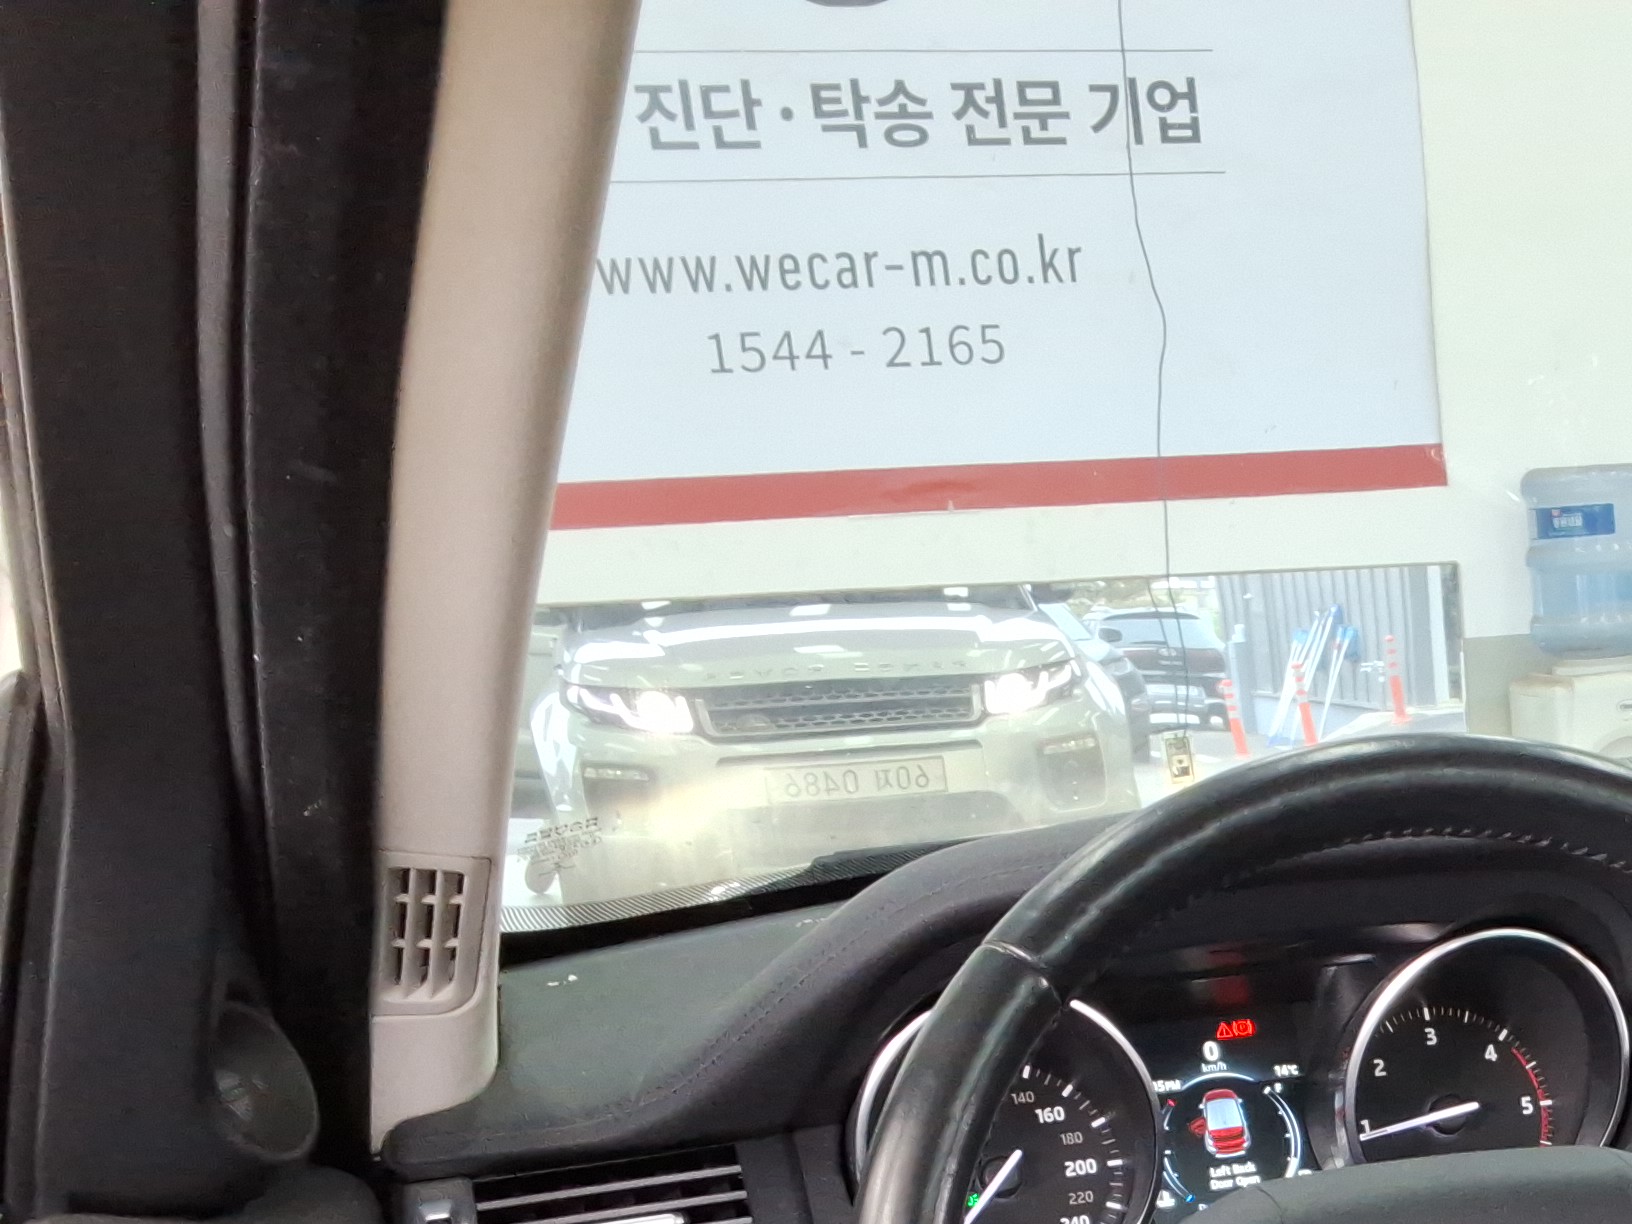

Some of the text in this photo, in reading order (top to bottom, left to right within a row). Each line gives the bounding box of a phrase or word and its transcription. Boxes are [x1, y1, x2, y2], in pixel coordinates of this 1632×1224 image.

[952, 76, 1070, 147] 전문
[1088, 76, 1202, 146] 기업
[597, 234, 1082, 295] www.wecar-m.co.kr
[707, 328, 834, 374] 1544
[884, 323, 1006, 369] 2165
[1424, 1027, 1438, 1046] 3
[1203, 1040, 1219, 1061] 0
[1484, 1044, 1498, 1062] 4
[1201, 1062, 1228, 1073] km/h
[1373, 1059, 1387, 1077] 2
[1011, 1090, 1035, 1105] 140
[1520, 1096, 1534, 1115] 5
[1035, 1106, 1065, 1123] 160
[1060, 1131, 1084, 1146] 180
[1064, 1158, 1097, 1177] 200
[1068, 1190, 1094, 1205] 220
